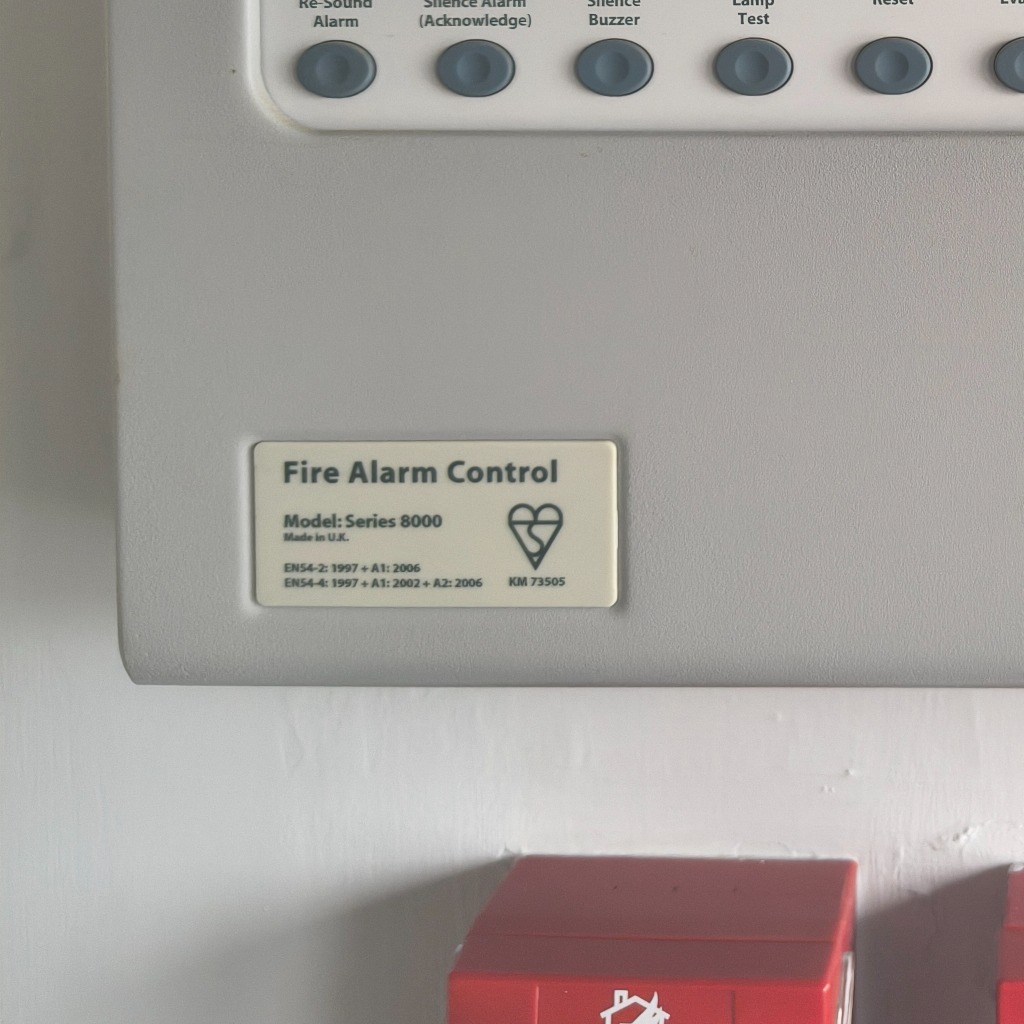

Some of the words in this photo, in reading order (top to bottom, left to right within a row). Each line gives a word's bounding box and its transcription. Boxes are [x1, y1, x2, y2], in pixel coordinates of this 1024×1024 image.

[313, 15, 358, 27] Alarm
[420, 14, 531, 29] (Acknowledge)
[589, 14, 640, 25] Buzzer
[738, 13, 769, 24] Test
[284, 460, 339, 483] Fire
[348, 460, 437, 483] Alarm
[447, 459, 557, 483] Control
[284, 514, 342, 528] Model:
[345, 514, 396, 528] Series
[400, 514, 442, 528] 8000
[283, 532, 313, 541] Made
[315, 533, 325, 541] in
[328, 533, 349, 542] U.K.
[284, 563, 328, 573] EN54-2:
[332, 563, 358, 572] 1997
[371, 563, 390, 572] A1:
[393, 563, 420, 572] 2006
[285, 578, 328, 588] EN54-4:
[332, 578, 358, 588] 1997
[371, 578, 390, 588] A1:
[393, 578, 420, 588] 2002
[433, 577, 452, 588] A2:
[454, 577, 483, 588] 2006
[509, 577, 528, 587] KM
[531, 577, 566, 587] 73505
